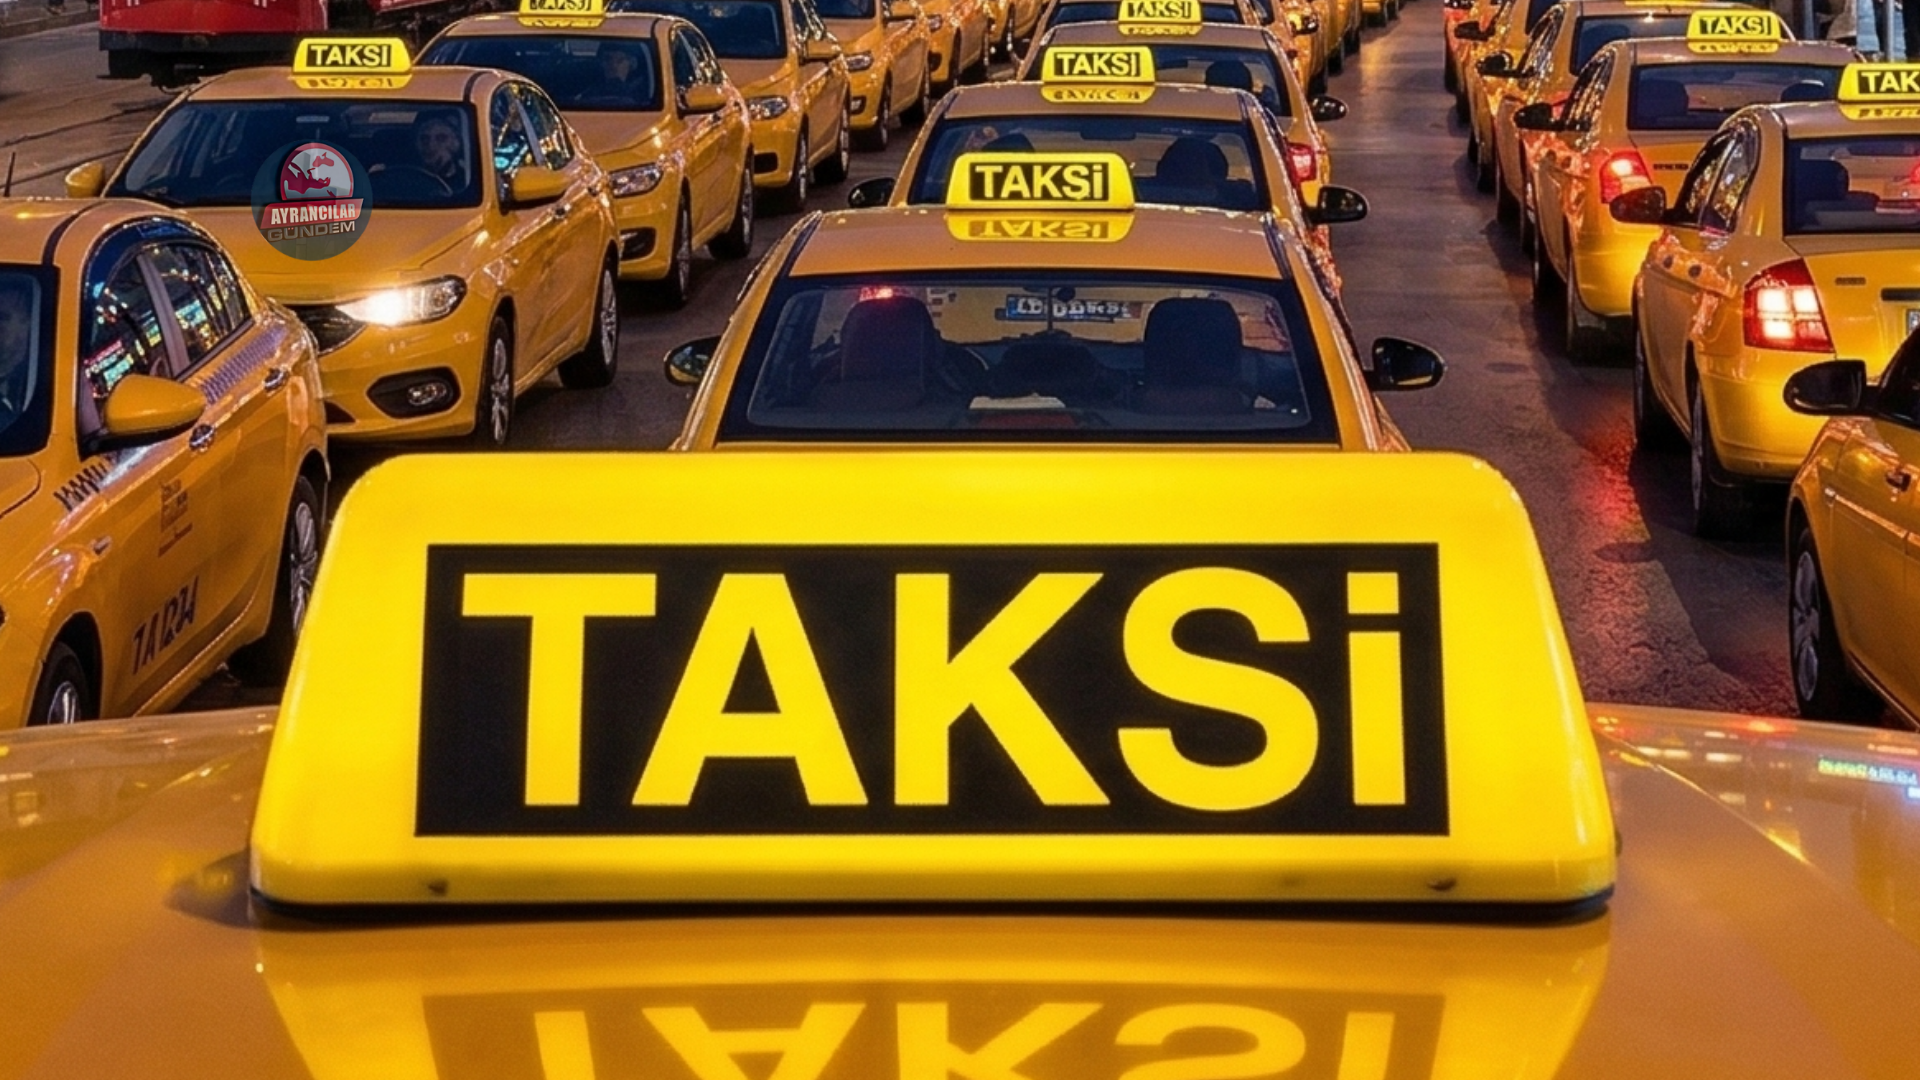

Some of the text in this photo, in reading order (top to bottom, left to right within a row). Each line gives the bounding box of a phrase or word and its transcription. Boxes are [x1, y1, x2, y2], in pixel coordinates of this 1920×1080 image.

[1702, 16, 1768, 34] TAKSI
[310, 45, 388, 66] TAKSI
[462, 567, 1407, 812] TAKSi
